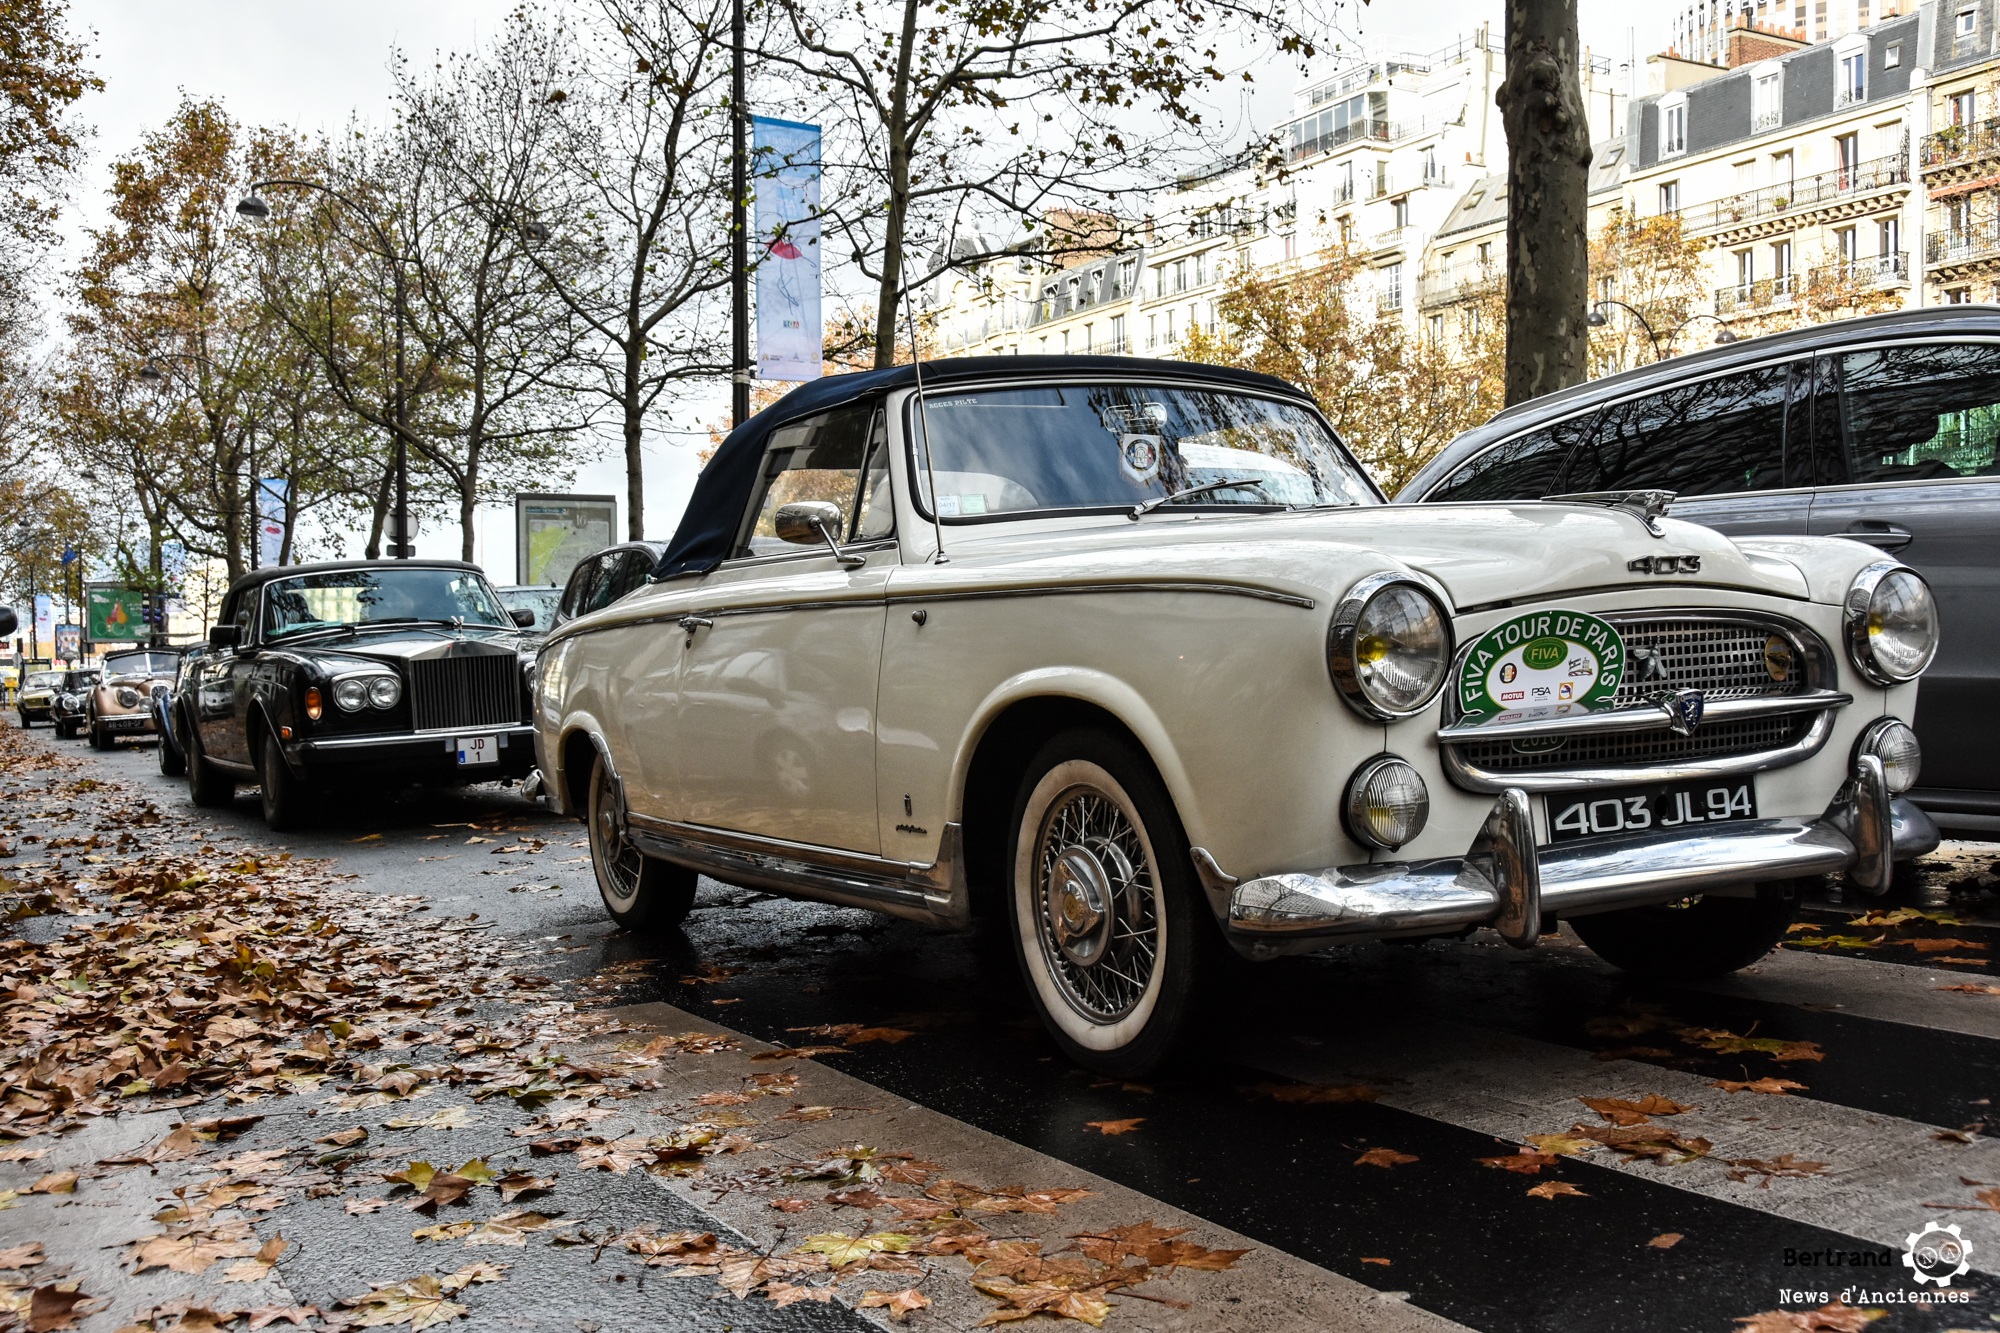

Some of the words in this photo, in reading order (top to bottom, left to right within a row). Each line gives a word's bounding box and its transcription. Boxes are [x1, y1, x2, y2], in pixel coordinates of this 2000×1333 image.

[929, 400, 953, 409] ACCES
[1627, 554, 1701, 575] 403
[1465, 650, 1494, 702] FIVA
[1492, 616, 1551, 650] TOUR
[1555, 616, 1585, 638] DE
[1584, 623, 1619, 688] PARIS
[1531, 646, 1559, 661] FIVA
[1501, 691, 1525, 700] MOTUL
[1531, 686, 1551, 697] PSA
[470, 738, 485, 750] JD
[475, 751, 481, 762] 1
[1554, 795, 1652, 835] 403
